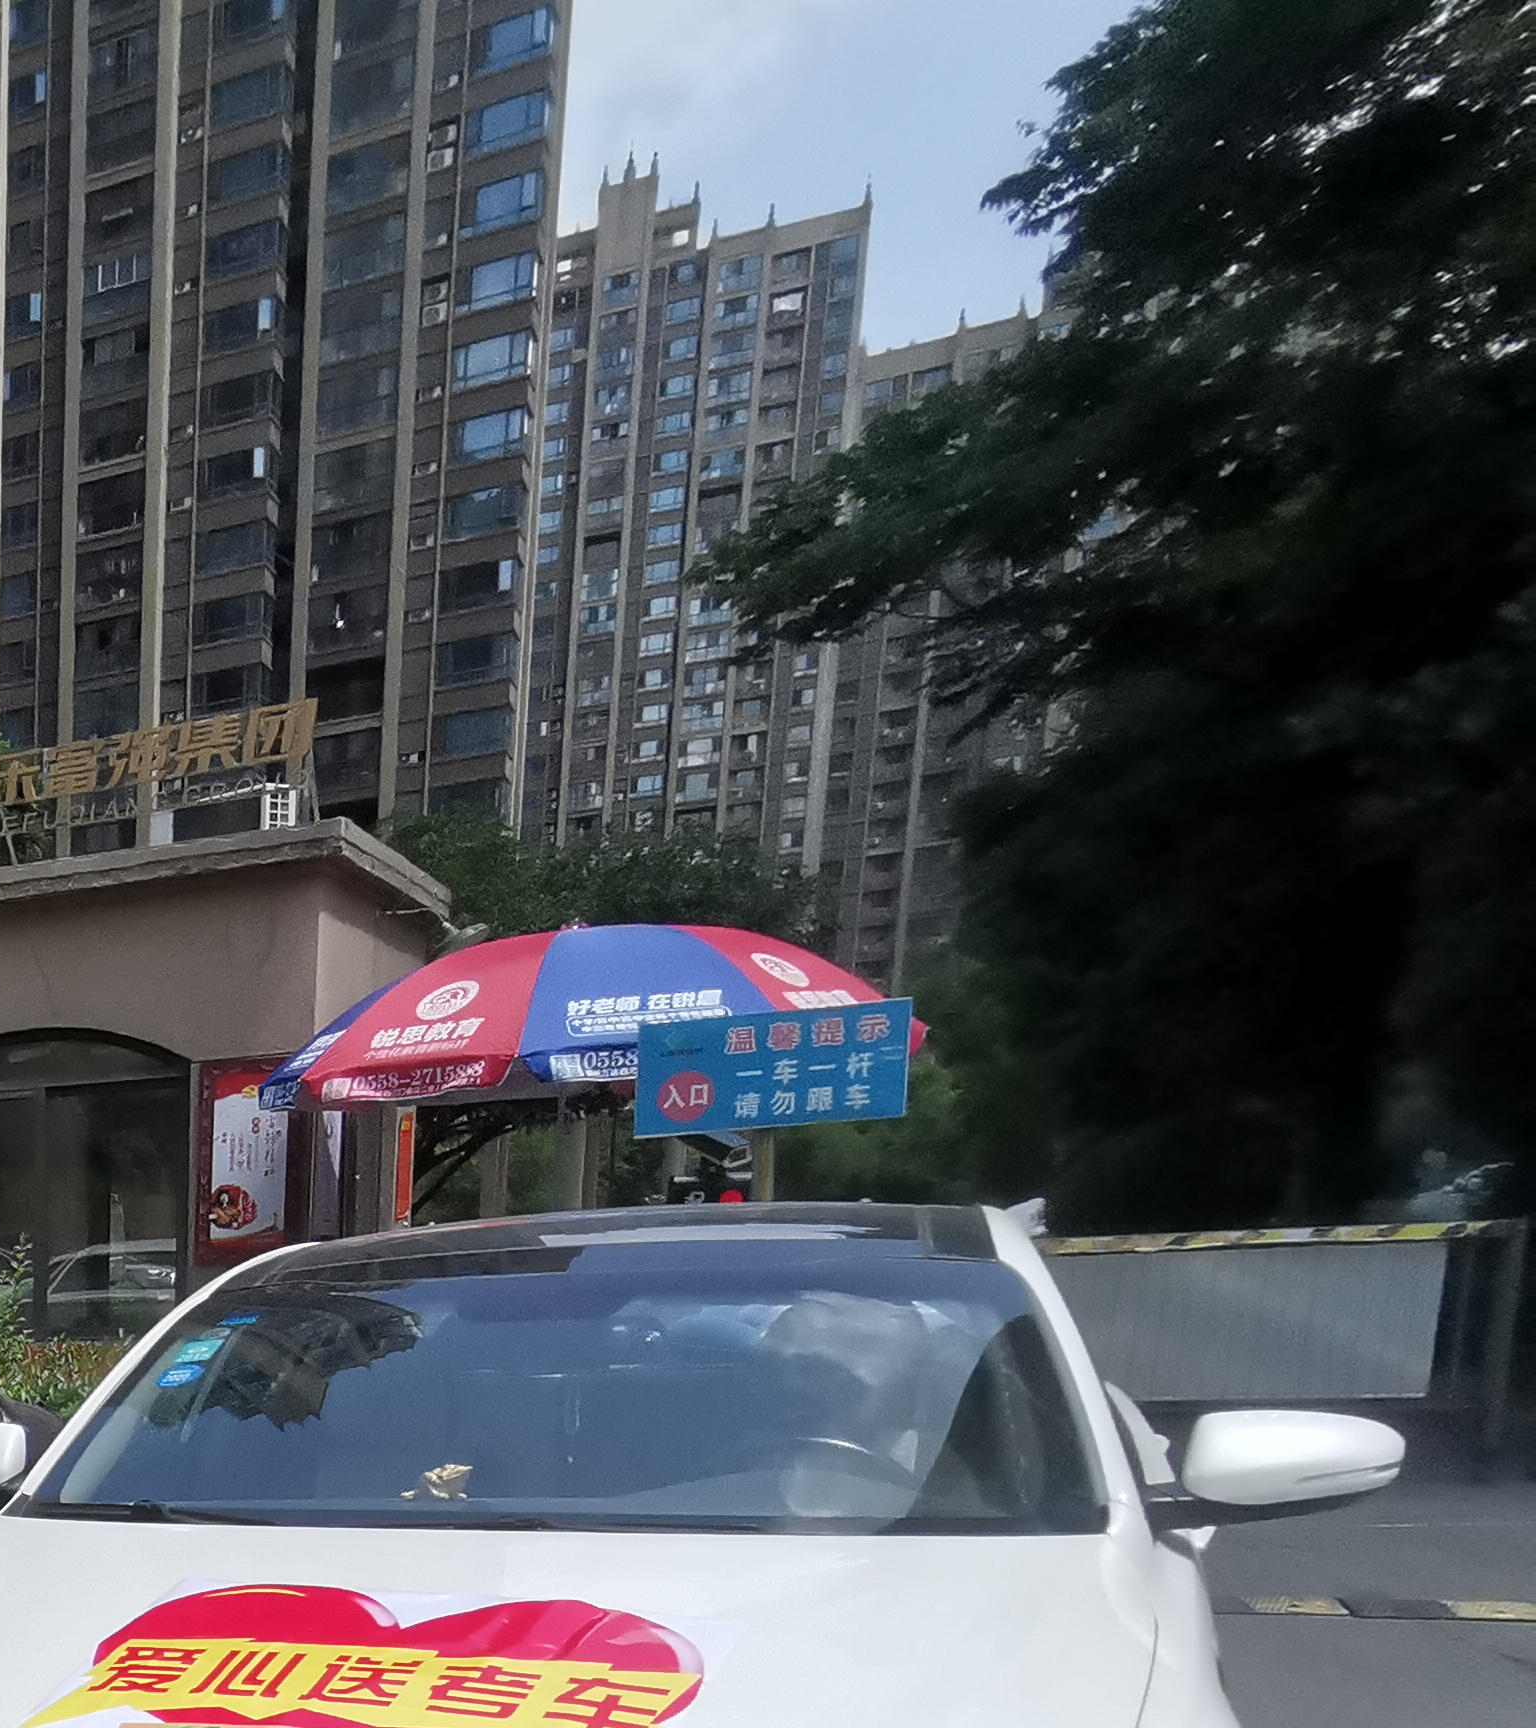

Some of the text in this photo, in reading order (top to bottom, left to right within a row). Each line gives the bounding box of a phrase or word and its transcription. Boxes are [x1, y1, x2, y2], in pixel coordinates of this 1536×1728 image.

[567, 995, 640, 1016] 好老师
[370, 1017, 485, 1049] 锐思教育
[724, 1013, 890, 1055] 温馨提示
[736, 1052, 874, 1085] 一车一杆
[663, 1083, 708, 1109] 入口
[734, 1084, 871, 1120] 请勿跟车
